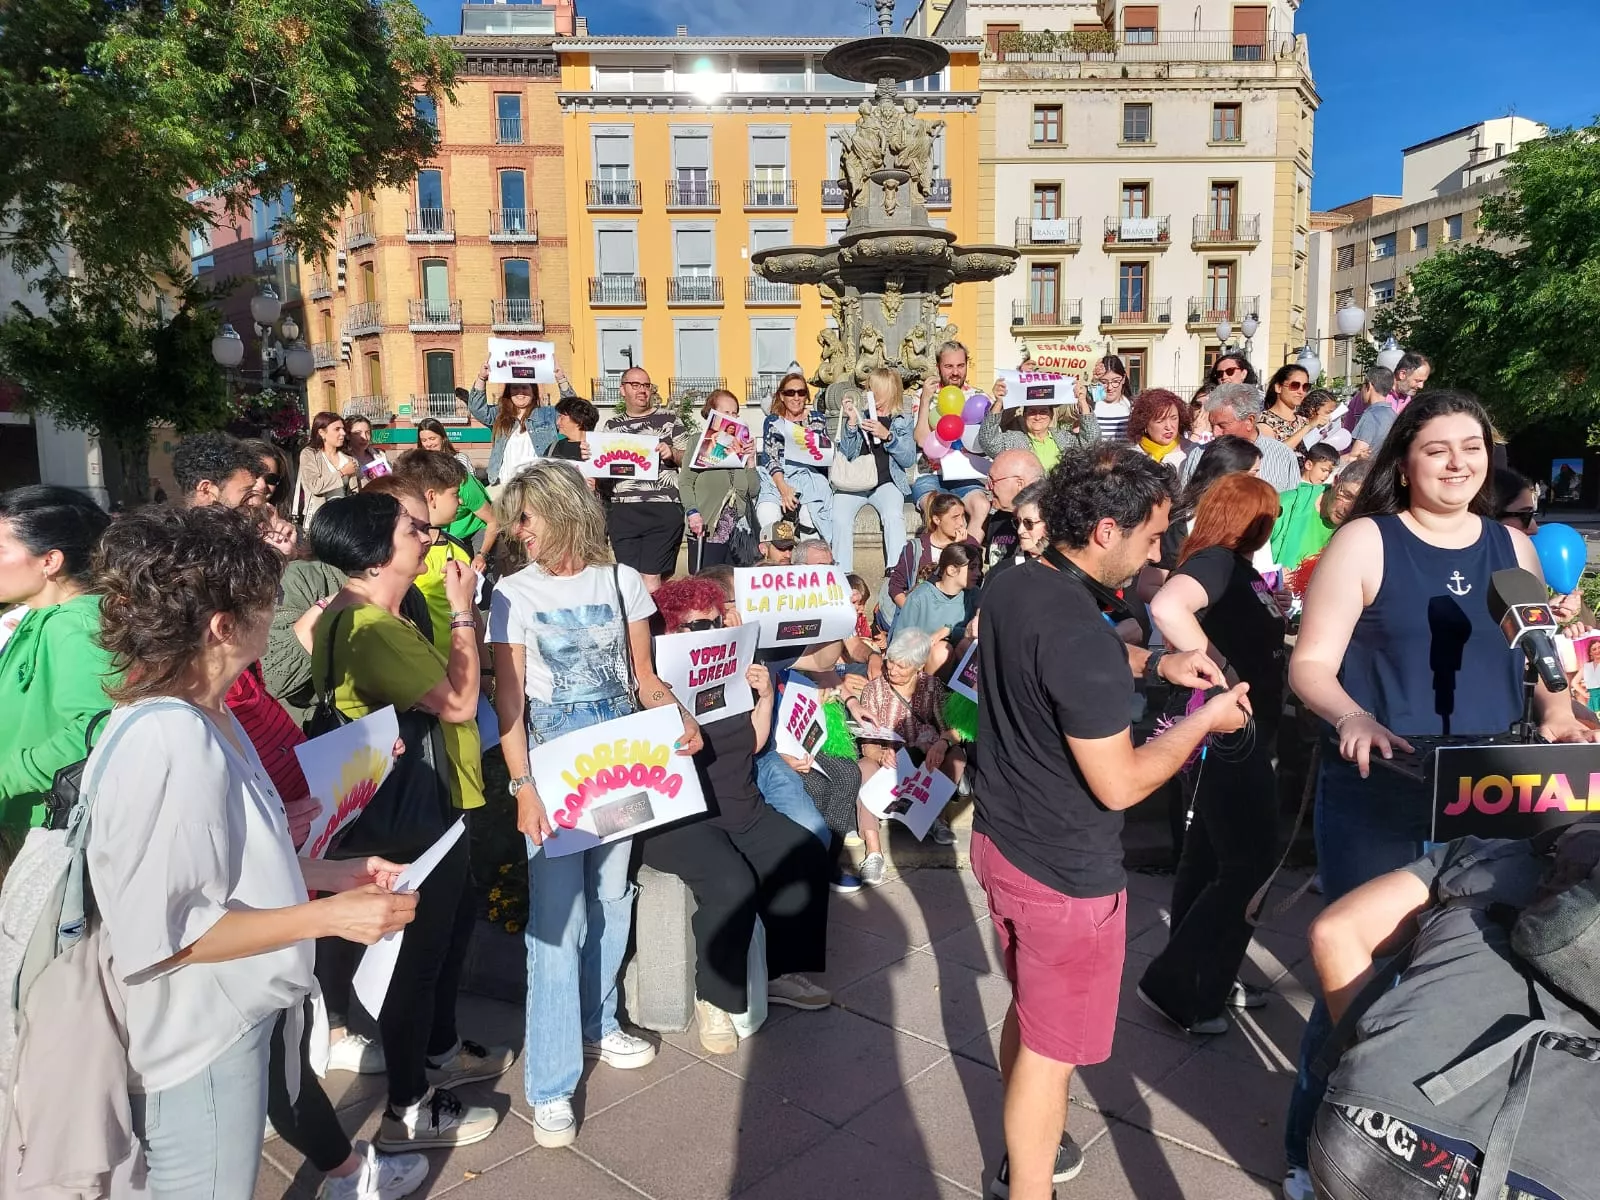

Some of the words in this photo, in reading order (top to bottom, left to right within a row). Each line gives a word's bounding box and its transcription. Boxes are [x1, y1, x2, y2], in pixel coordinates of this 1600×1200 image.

[824, 187, 842, 196] POD
[1036, 343, 1093, 353] ESTAMOS
[1037, 356, 1087, 369] CONTIGO
[1019, 372, 1063, 384] LORENA
[593, 449, 652, 472] GANADORA
[751, 571, 820, 591] LORENA
[826, 571, 836, 586] A
[746, 595, 770, 613] LA
[776, 584, 844, 612] FINAL!!!
[689, 644, 727, 667] VOTA
[728, 641, 737, 658] A
[688, 657, 738, 688] LORENA
[794, 699, 818, 742] ORENA
[560, 738, 671, 792] LORENA
[553, 762, 684, 830] GANADORA
